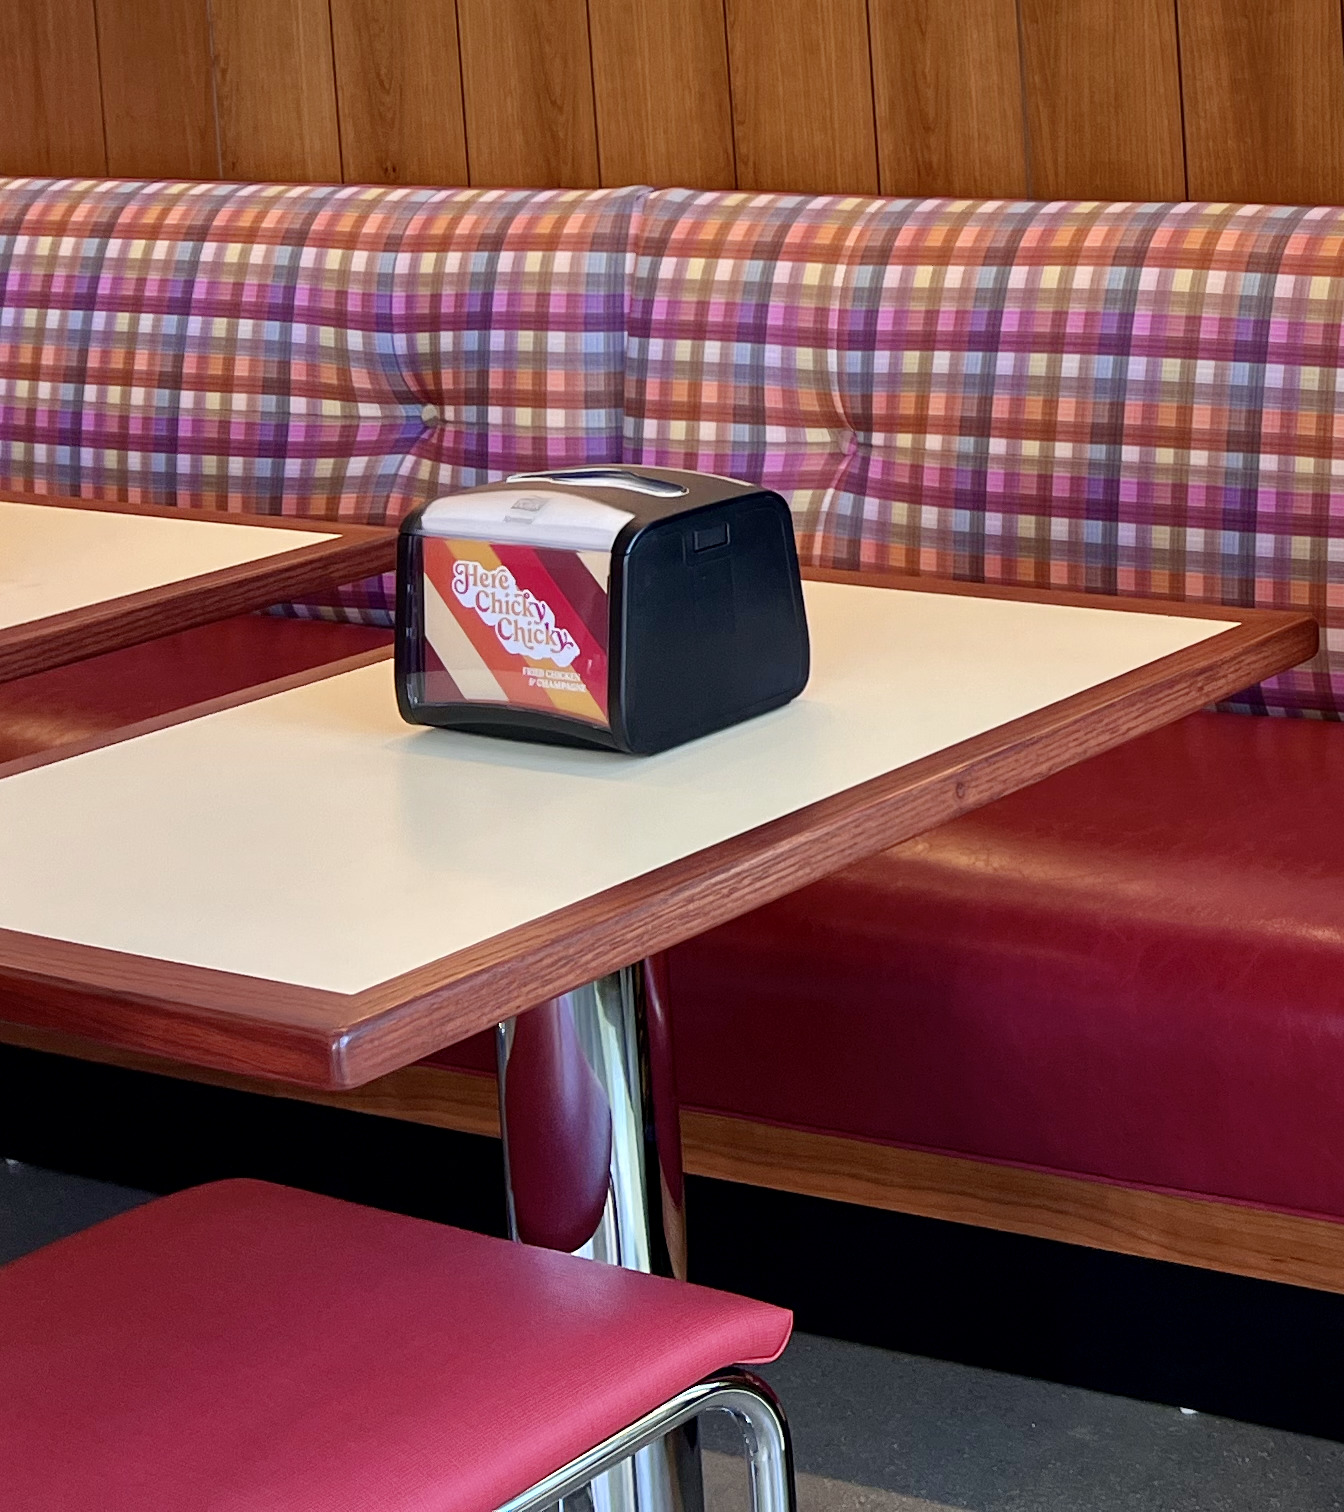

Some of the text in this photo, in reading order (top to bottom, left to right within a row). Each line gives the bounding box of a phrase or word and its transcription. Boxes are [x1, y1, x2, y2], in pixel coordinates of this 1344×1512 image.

[454, 563, 510, 595] Here
[475, 589, 546, 623] Chicky
[497, 617, 574, 654] Chicky
